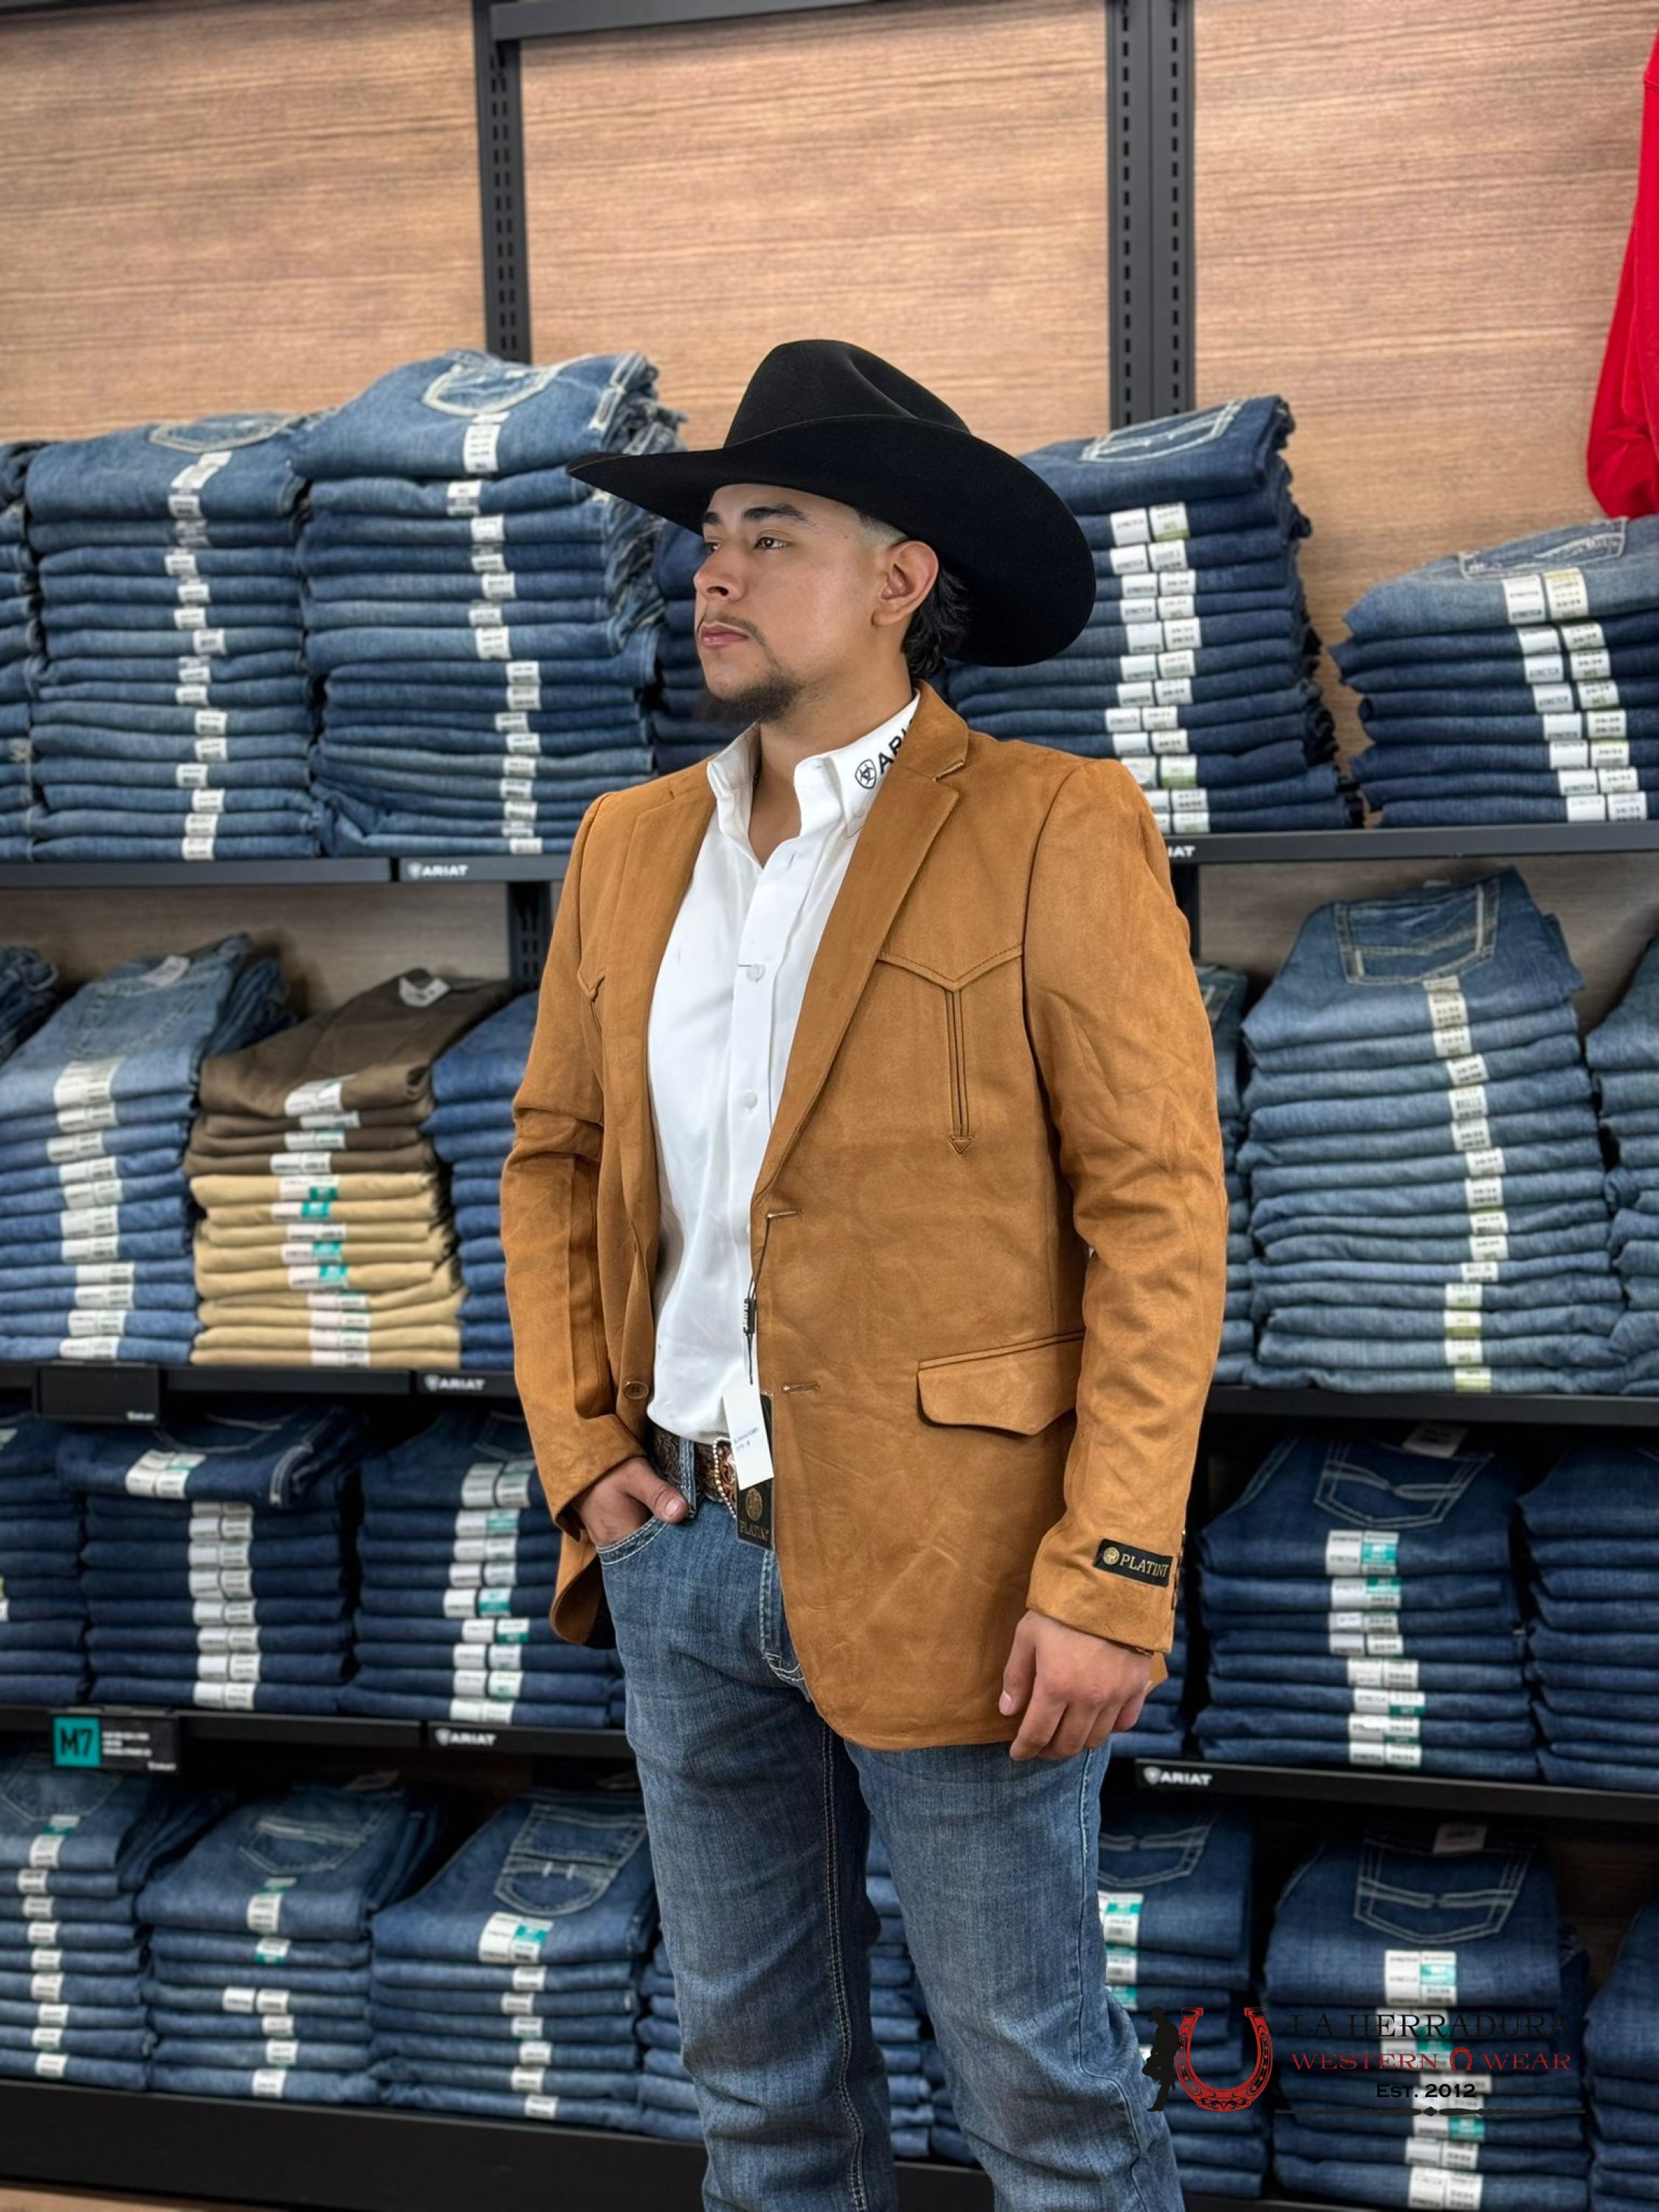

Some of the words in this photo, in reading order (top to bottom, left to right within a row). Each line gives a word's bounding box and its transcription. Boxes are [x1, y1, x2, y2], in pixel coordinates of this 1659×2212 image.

[877, 719, 913, 775] AR
[422, 863, 468, 877] ARIAT
[60, 1727, 93, 1756] M7
[451, 1732, 496, 1747] ARIAT
[1161, 1770, 1213, 1787] ARIAT
